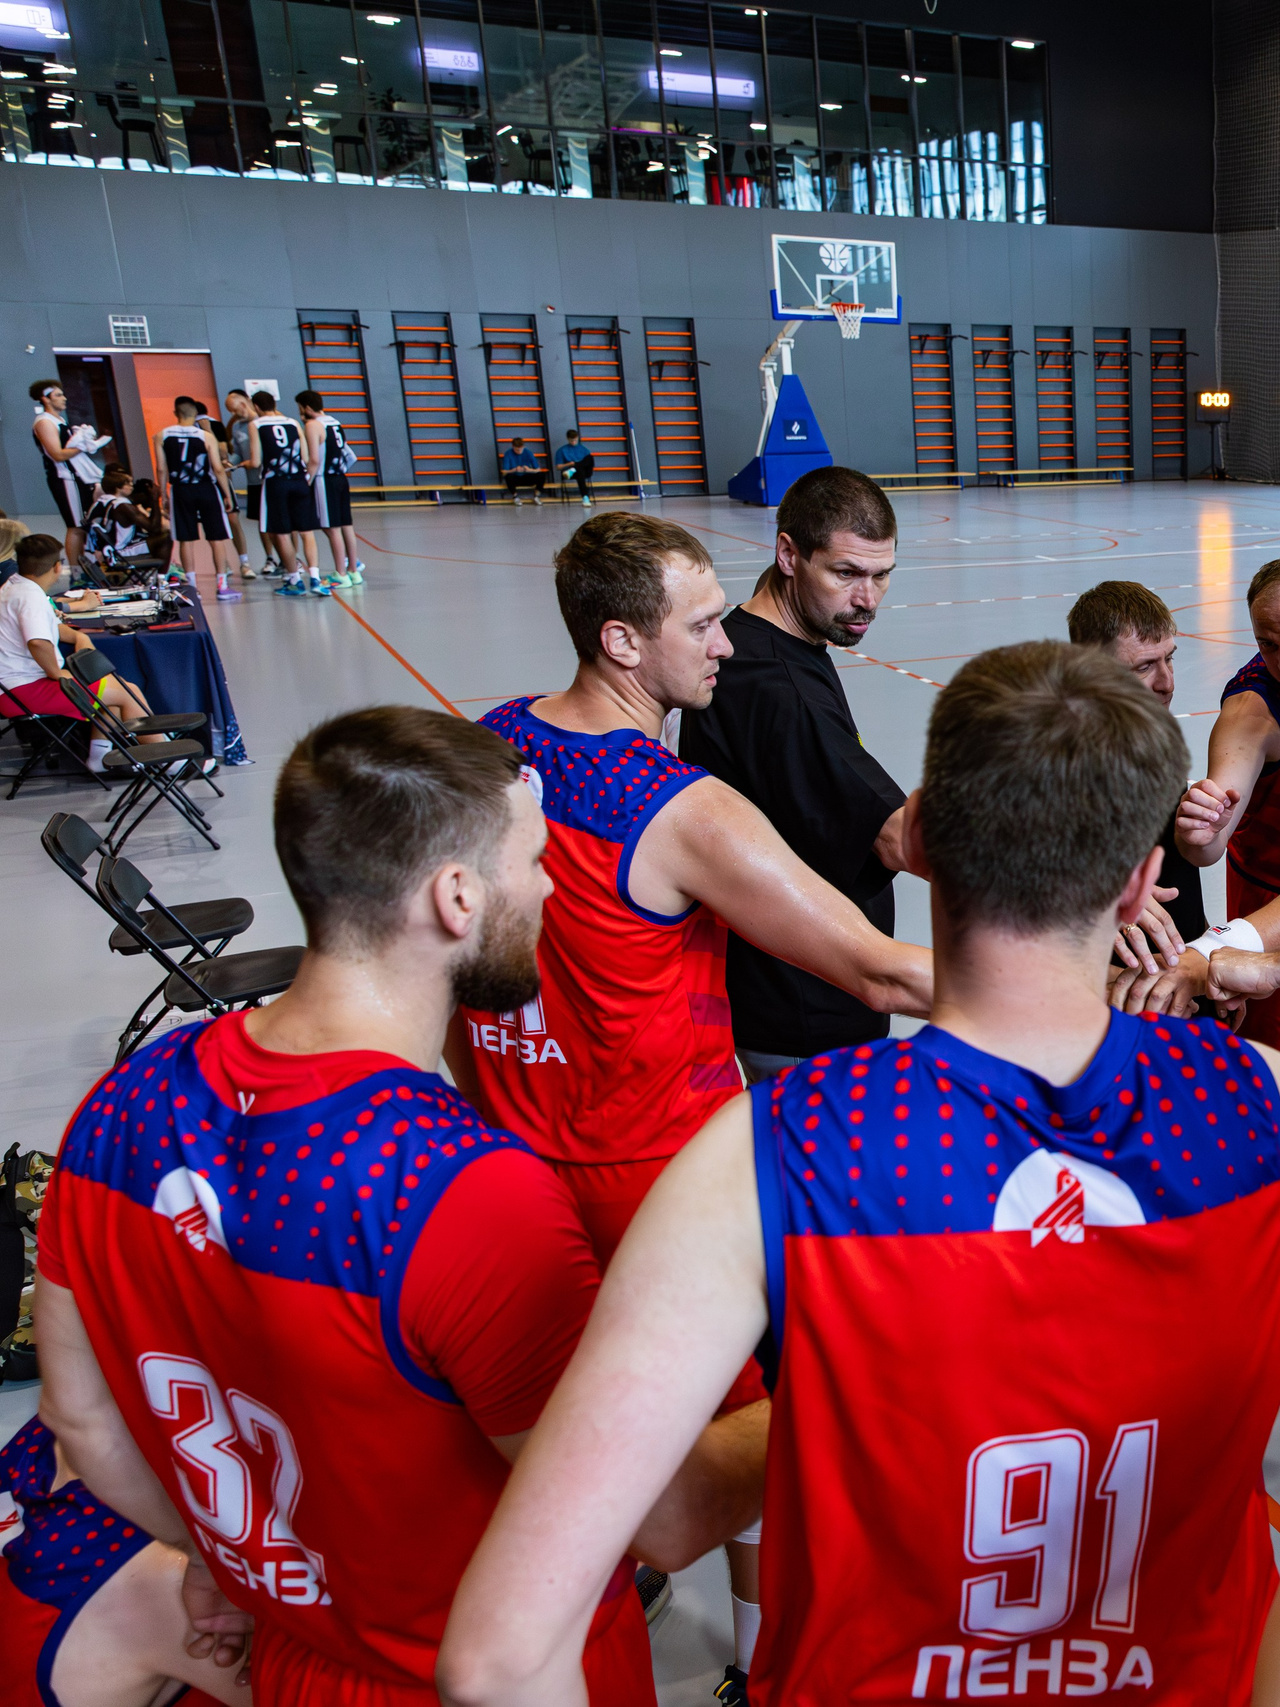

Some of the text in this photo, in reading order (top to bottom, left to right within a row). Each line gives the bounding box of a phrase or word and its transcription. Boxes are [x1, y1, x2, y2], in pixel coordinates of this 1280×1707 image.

[1200, 392, 1230, 407] 10:00
[272, 425, 289, 448] 9
[331, 425, 344, 448] 5
[178, 438, 189, 462] 7
[137, 1351, 327, 1585] 32
[959, 1418, 1159, 1642] 91
[911, 1638, 1154, 1699] ПЕНЗА
